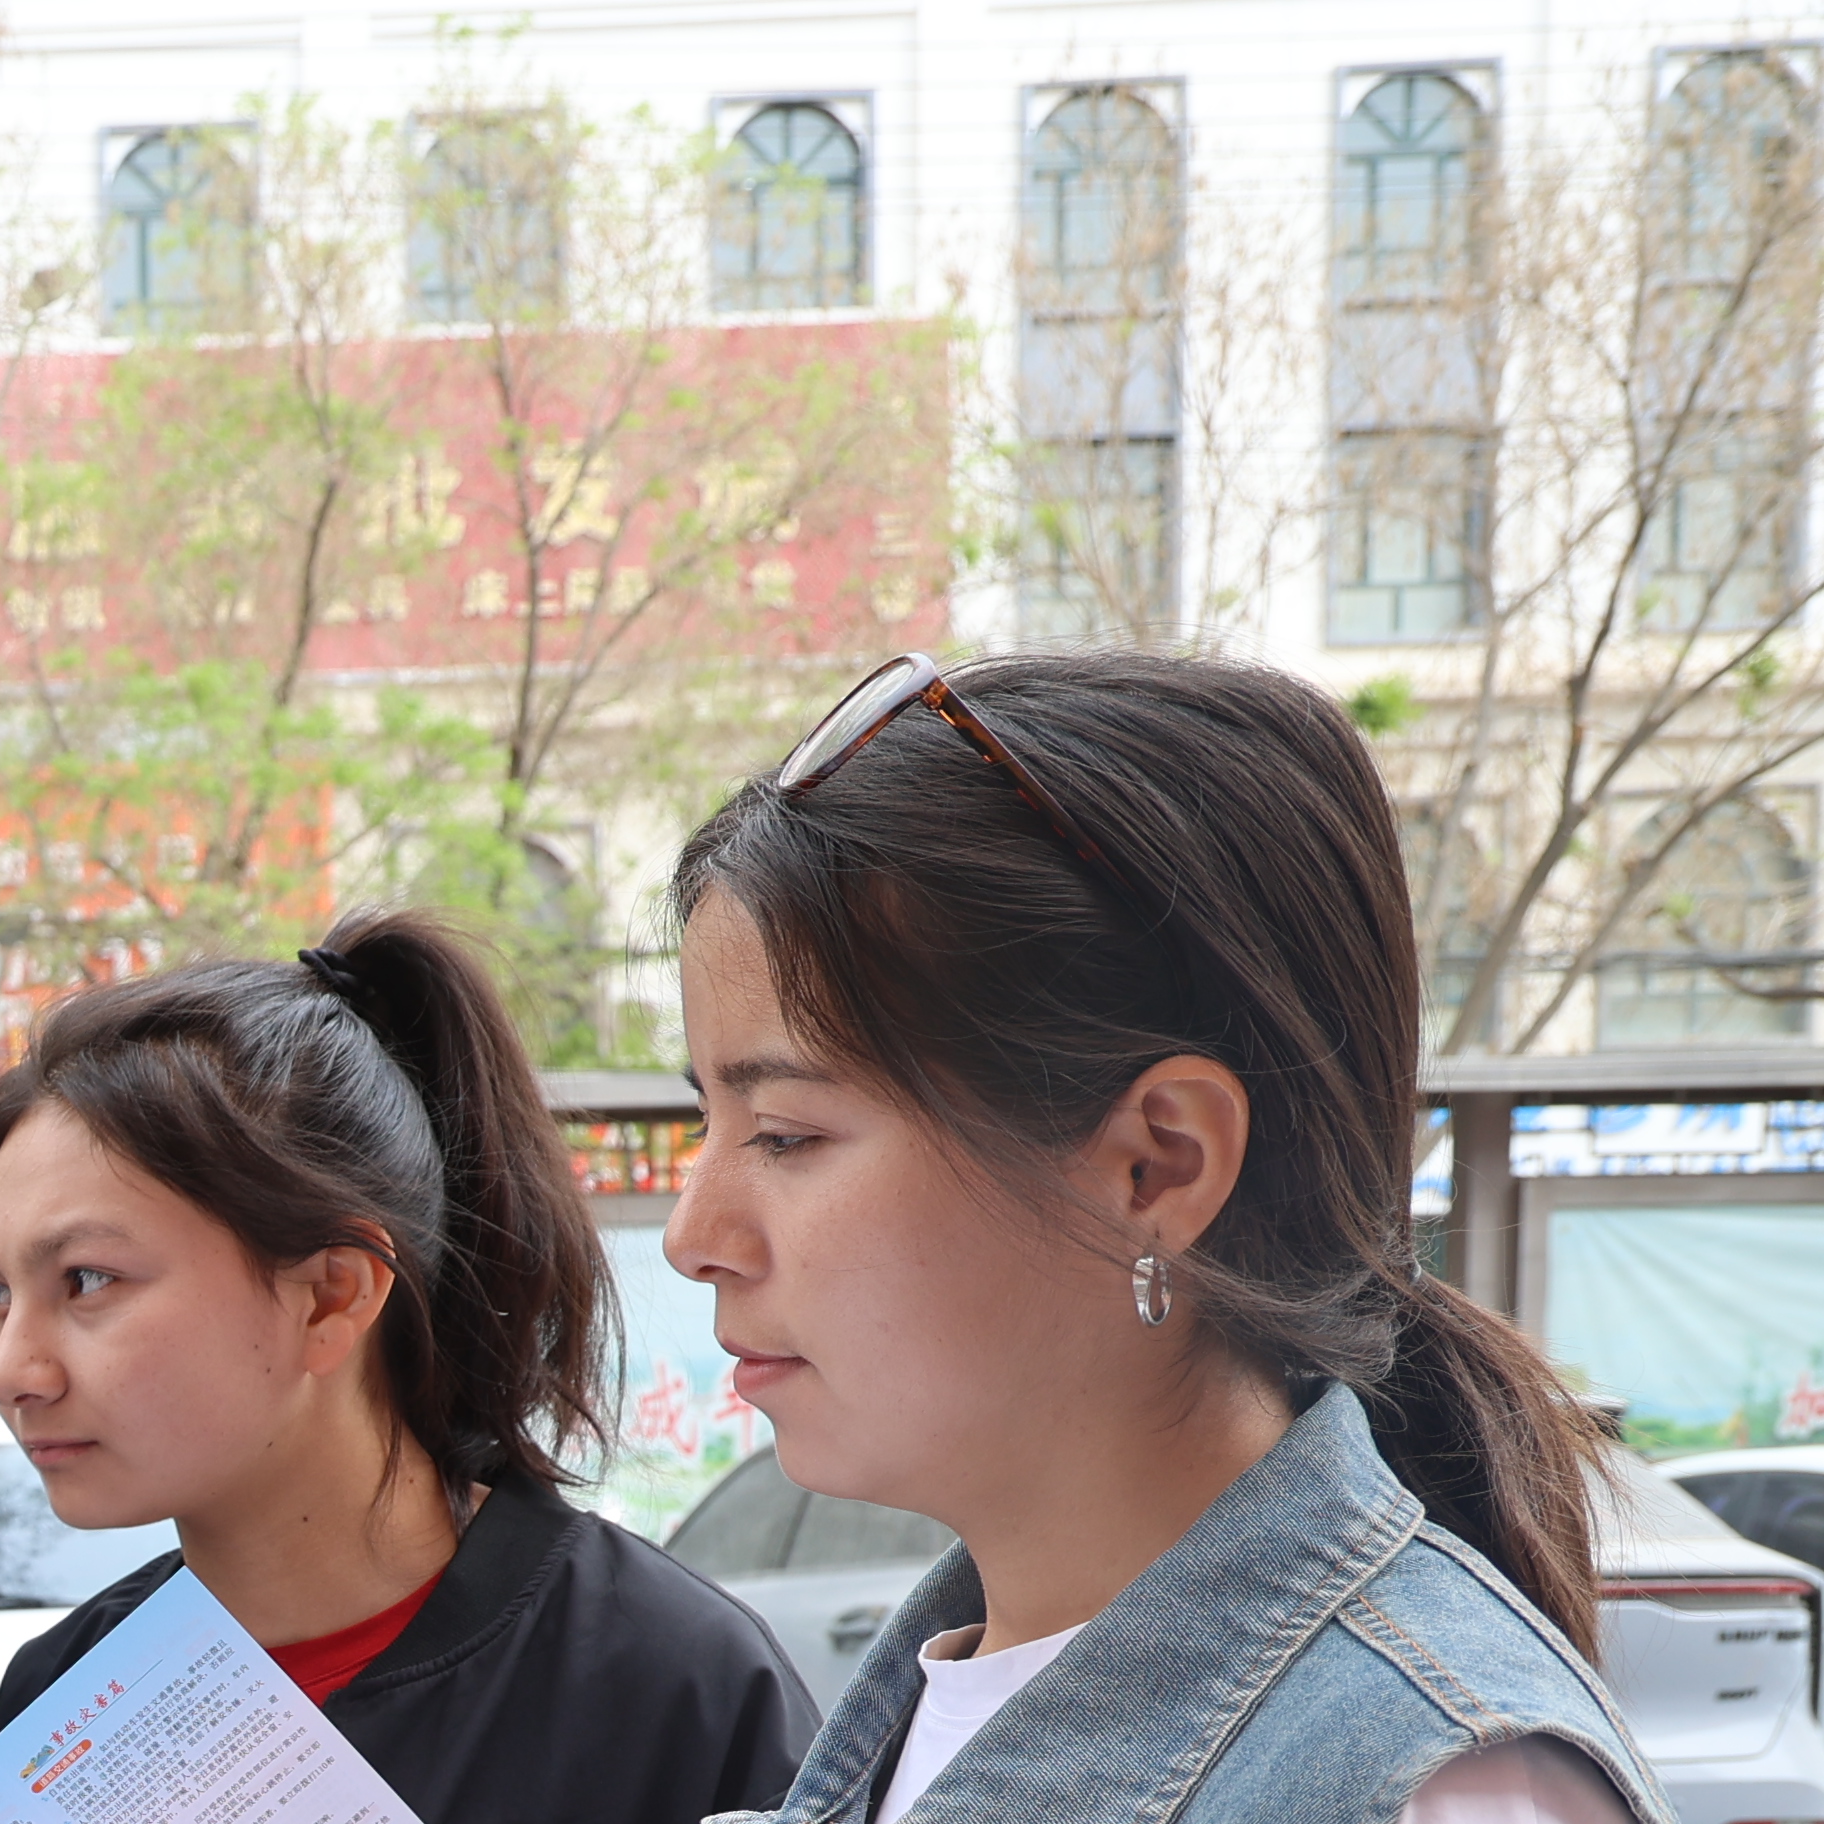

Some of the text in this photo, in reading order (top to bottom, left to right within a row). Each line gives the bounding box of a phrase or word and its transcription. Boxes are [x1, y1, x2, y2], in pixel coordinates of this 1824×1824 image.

[45, 1676, 127, 1750] 事故灾害篇
